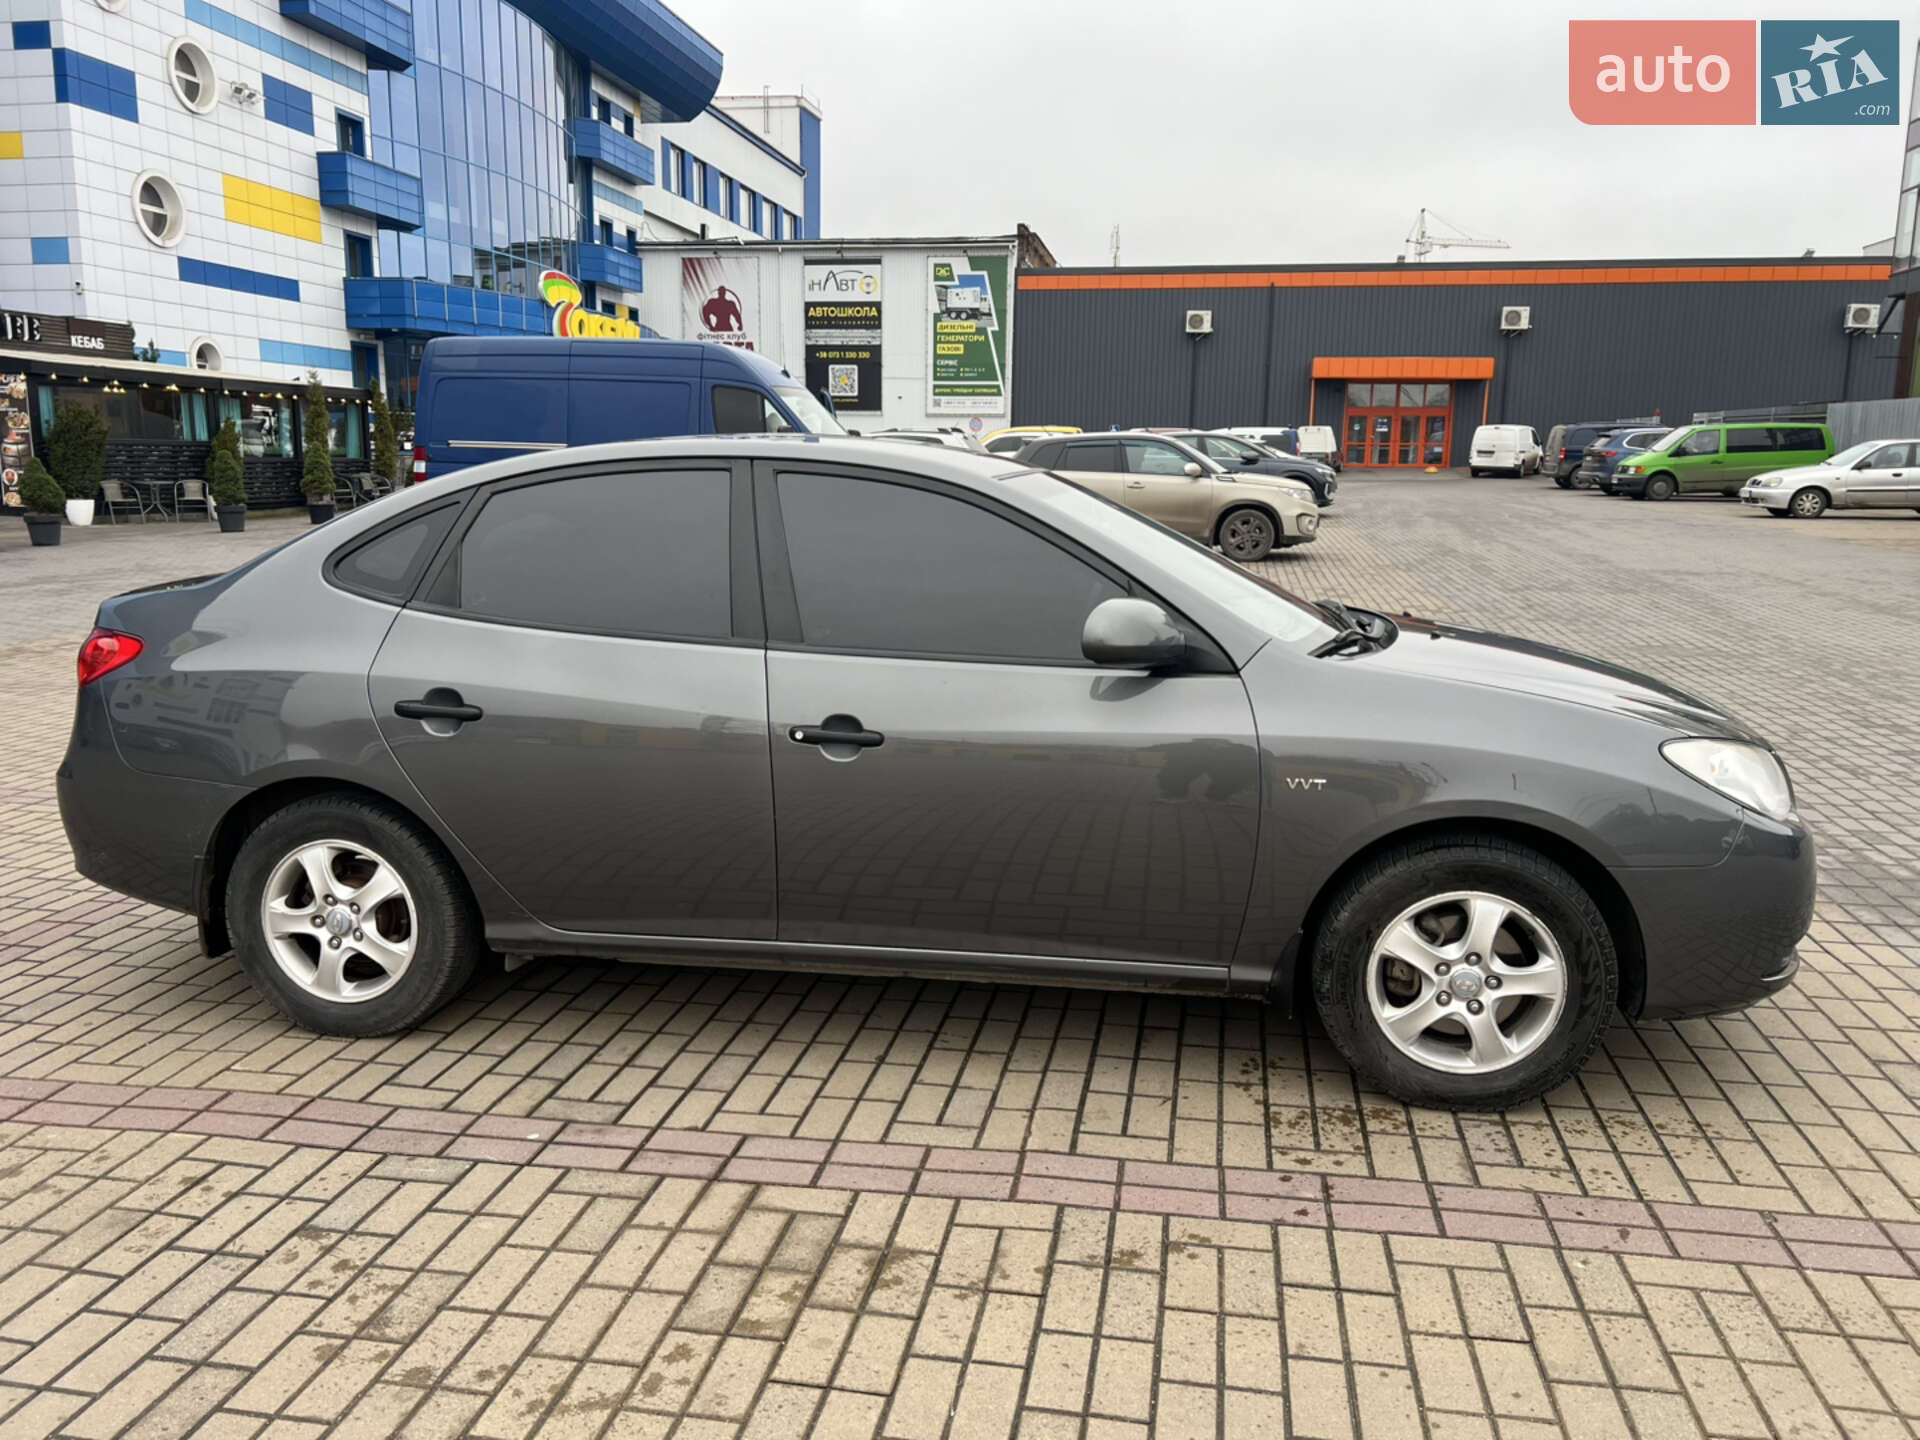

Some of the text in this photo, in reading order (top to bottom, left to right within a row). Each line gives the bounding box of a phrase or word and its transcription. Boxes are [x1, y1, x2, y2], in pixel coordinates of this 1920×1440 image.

[807, 306, 878, 318] АВТОШКОЛА
[71, 335, 105, 350] КЕБАБ
[727, 332, 747, 341] клуб
[1286, 777, 1327, 790] VVT
